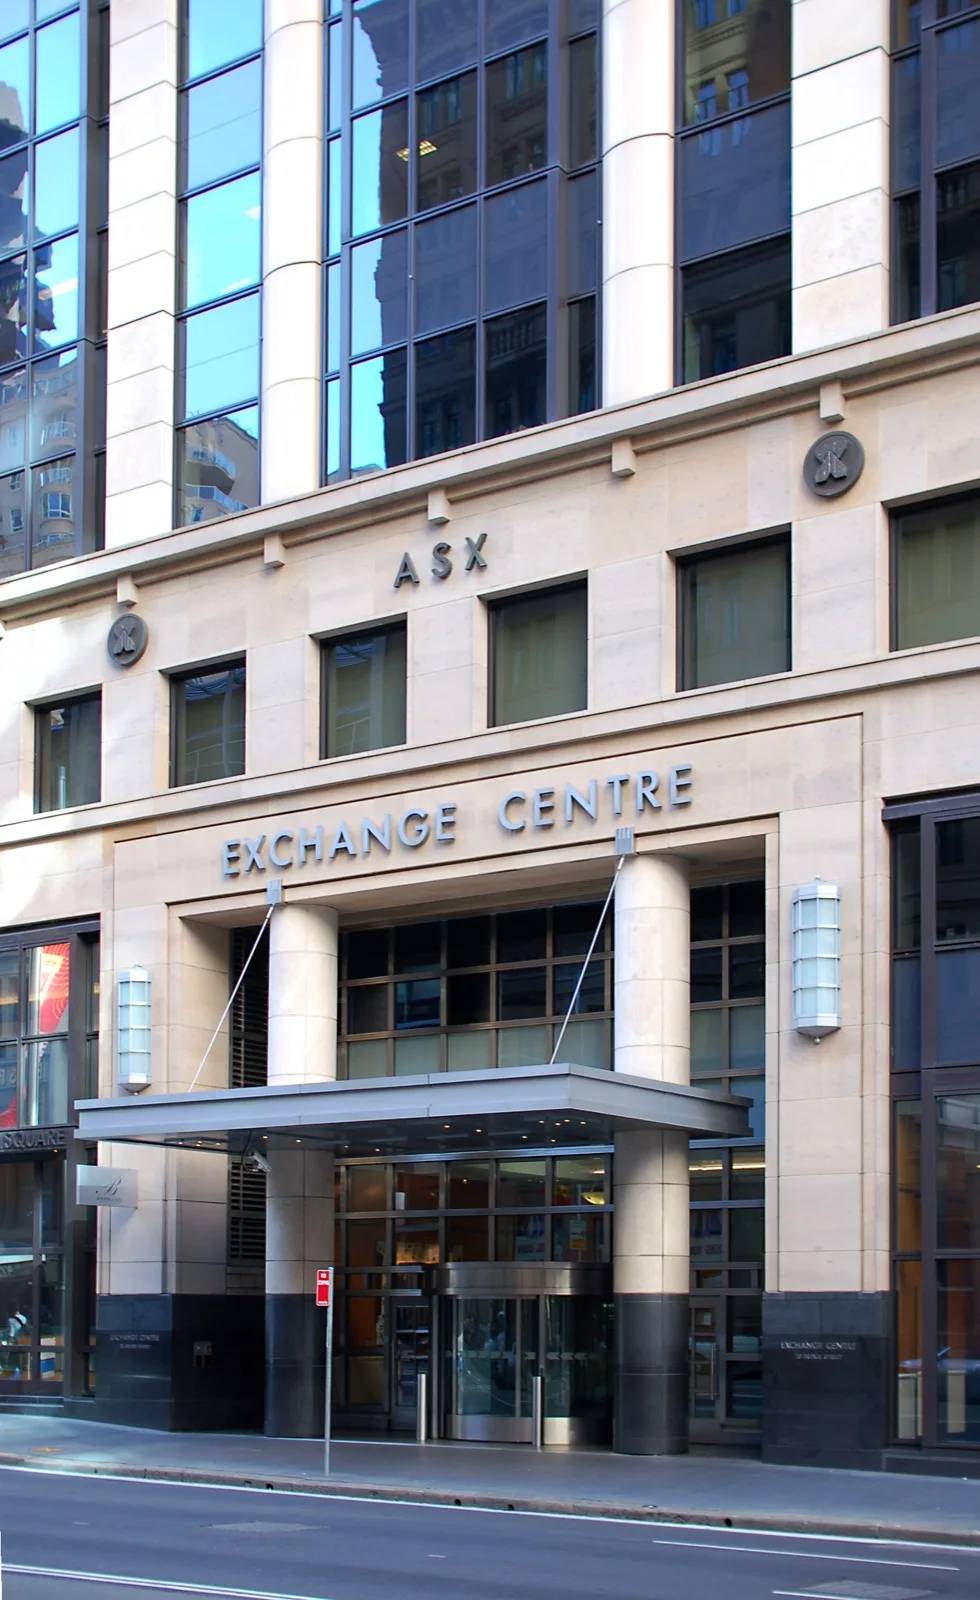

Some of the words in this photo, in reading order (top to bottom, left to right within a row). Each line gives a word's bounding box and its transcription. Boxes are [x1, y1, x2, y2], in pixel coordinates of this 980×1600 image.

[393, 533, 488, 588] ASX
[223, 803, 457, 876] EXCHANGE
[499, 763, 693, 832] CENTRE
[3, 1130, 66, 1149] SQUARE
[780, 1341, 824, 1350] EXCHANGE
[826, 1342, 857, 1351] CENTRE
